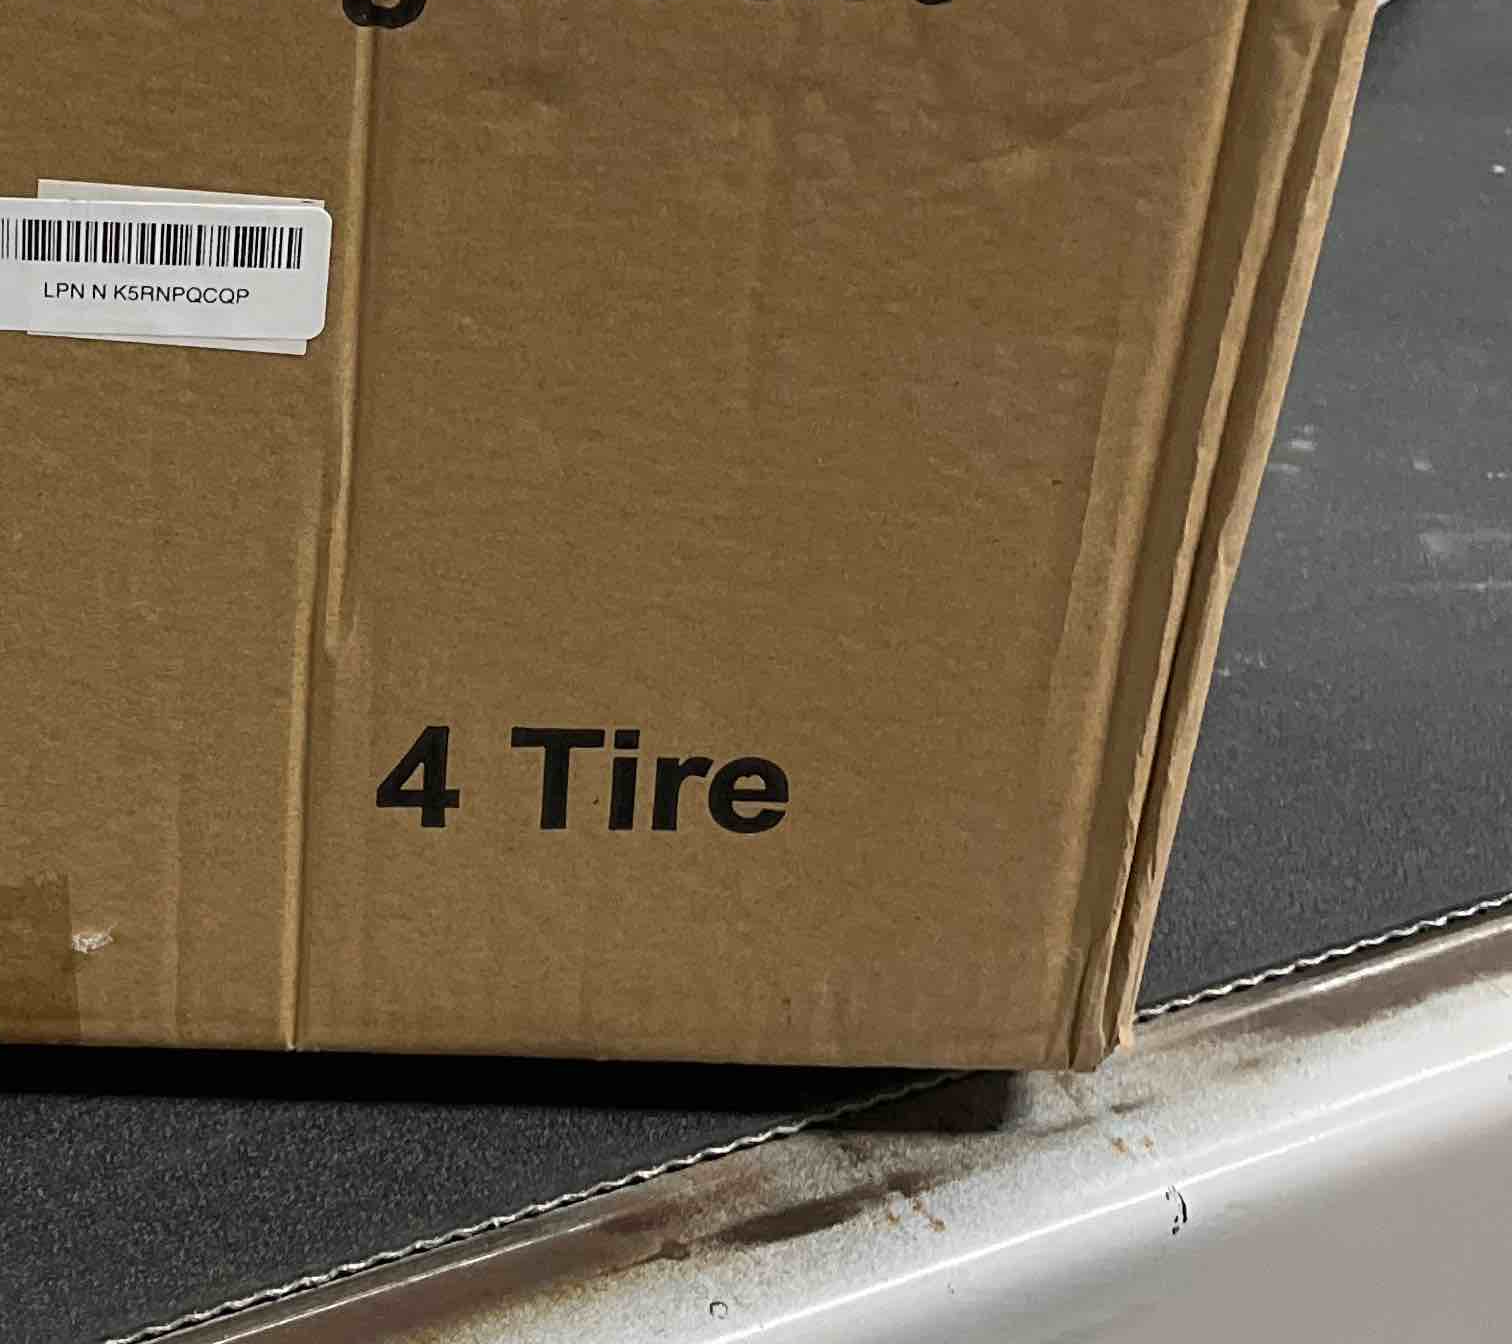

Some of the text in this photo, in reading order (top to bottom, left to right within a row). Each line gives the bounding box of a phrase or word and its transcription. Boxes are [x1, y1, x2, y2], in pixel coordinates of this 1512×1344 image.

[43, 280, 250, 304] LPN N K5RNPQCQP
[375, 725, 790, 834] 4 Tire
